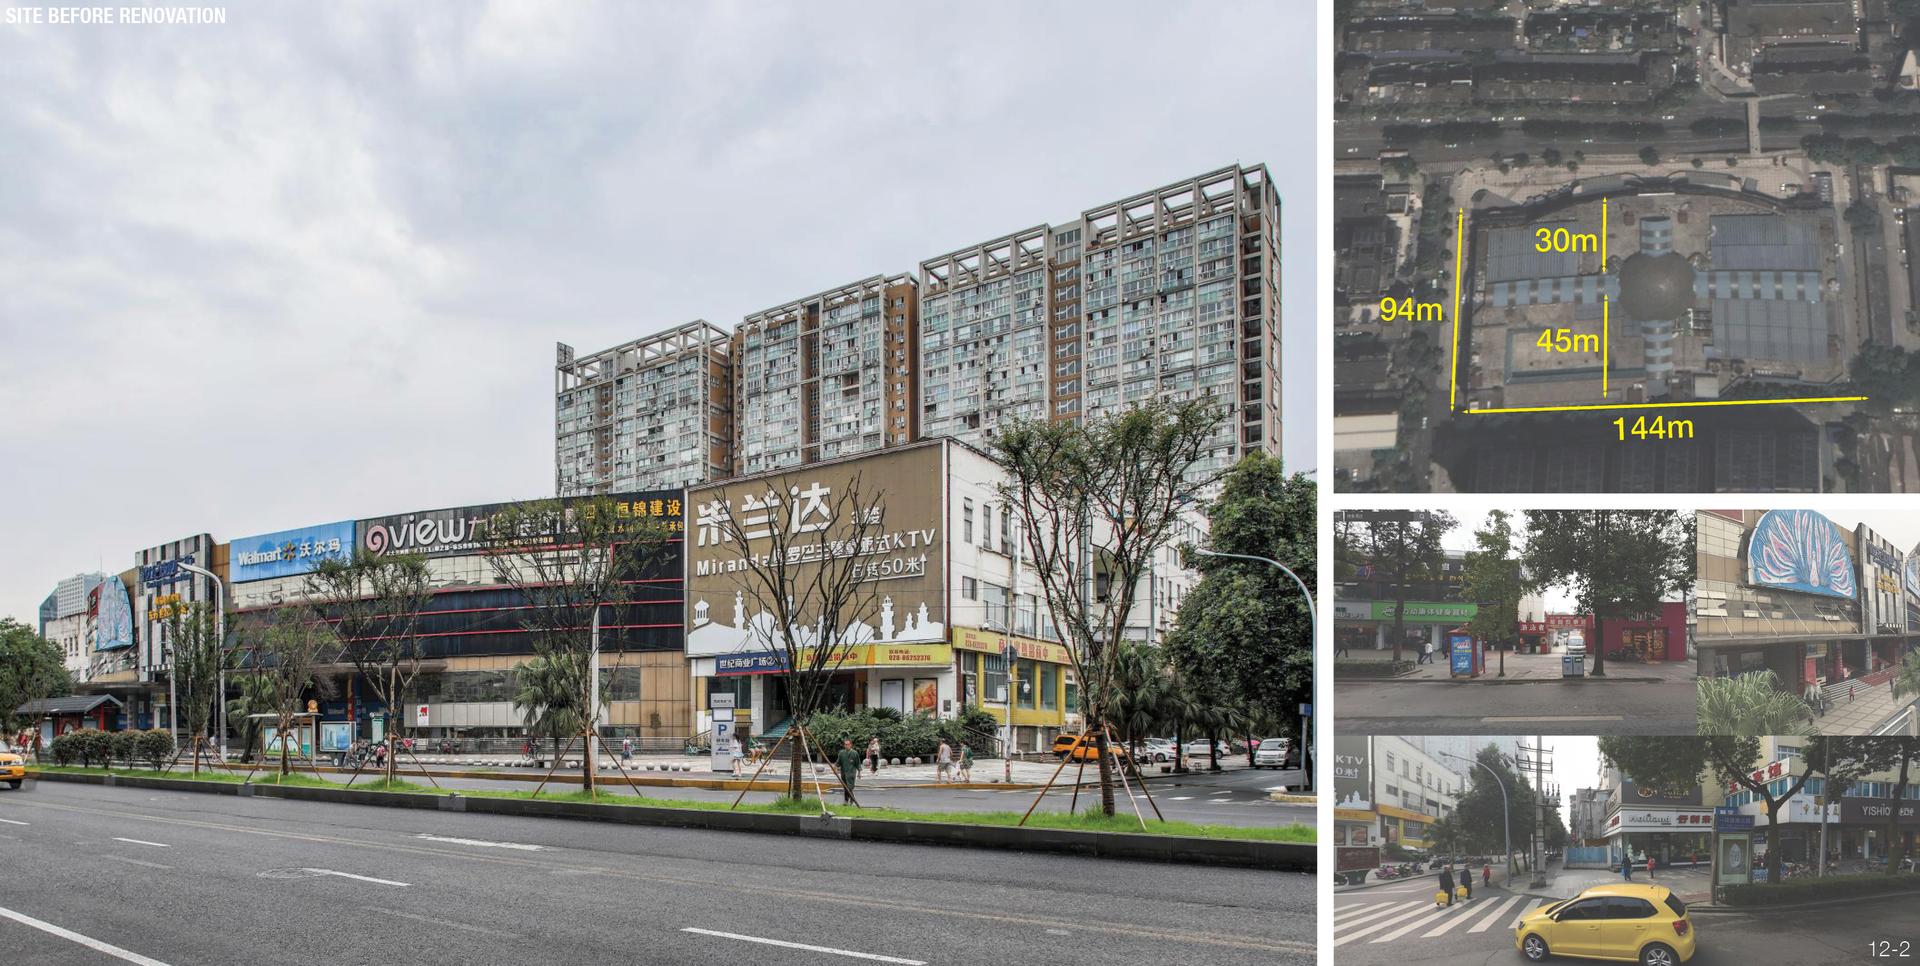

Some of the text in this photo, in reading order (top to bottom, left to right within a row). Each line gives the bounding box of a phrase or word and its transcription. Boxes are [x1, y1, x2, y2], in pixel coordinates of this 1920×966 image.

[696, 482, 831, 547] 米兰达
[238, 546, 281, 567] Walmart
[300, 537, 342, 558] 沃尔玛
[696, 553, 770, 577] Miranda
[718, 724, 727, 736] P
[1335, 754, 1364, 766] KTV
